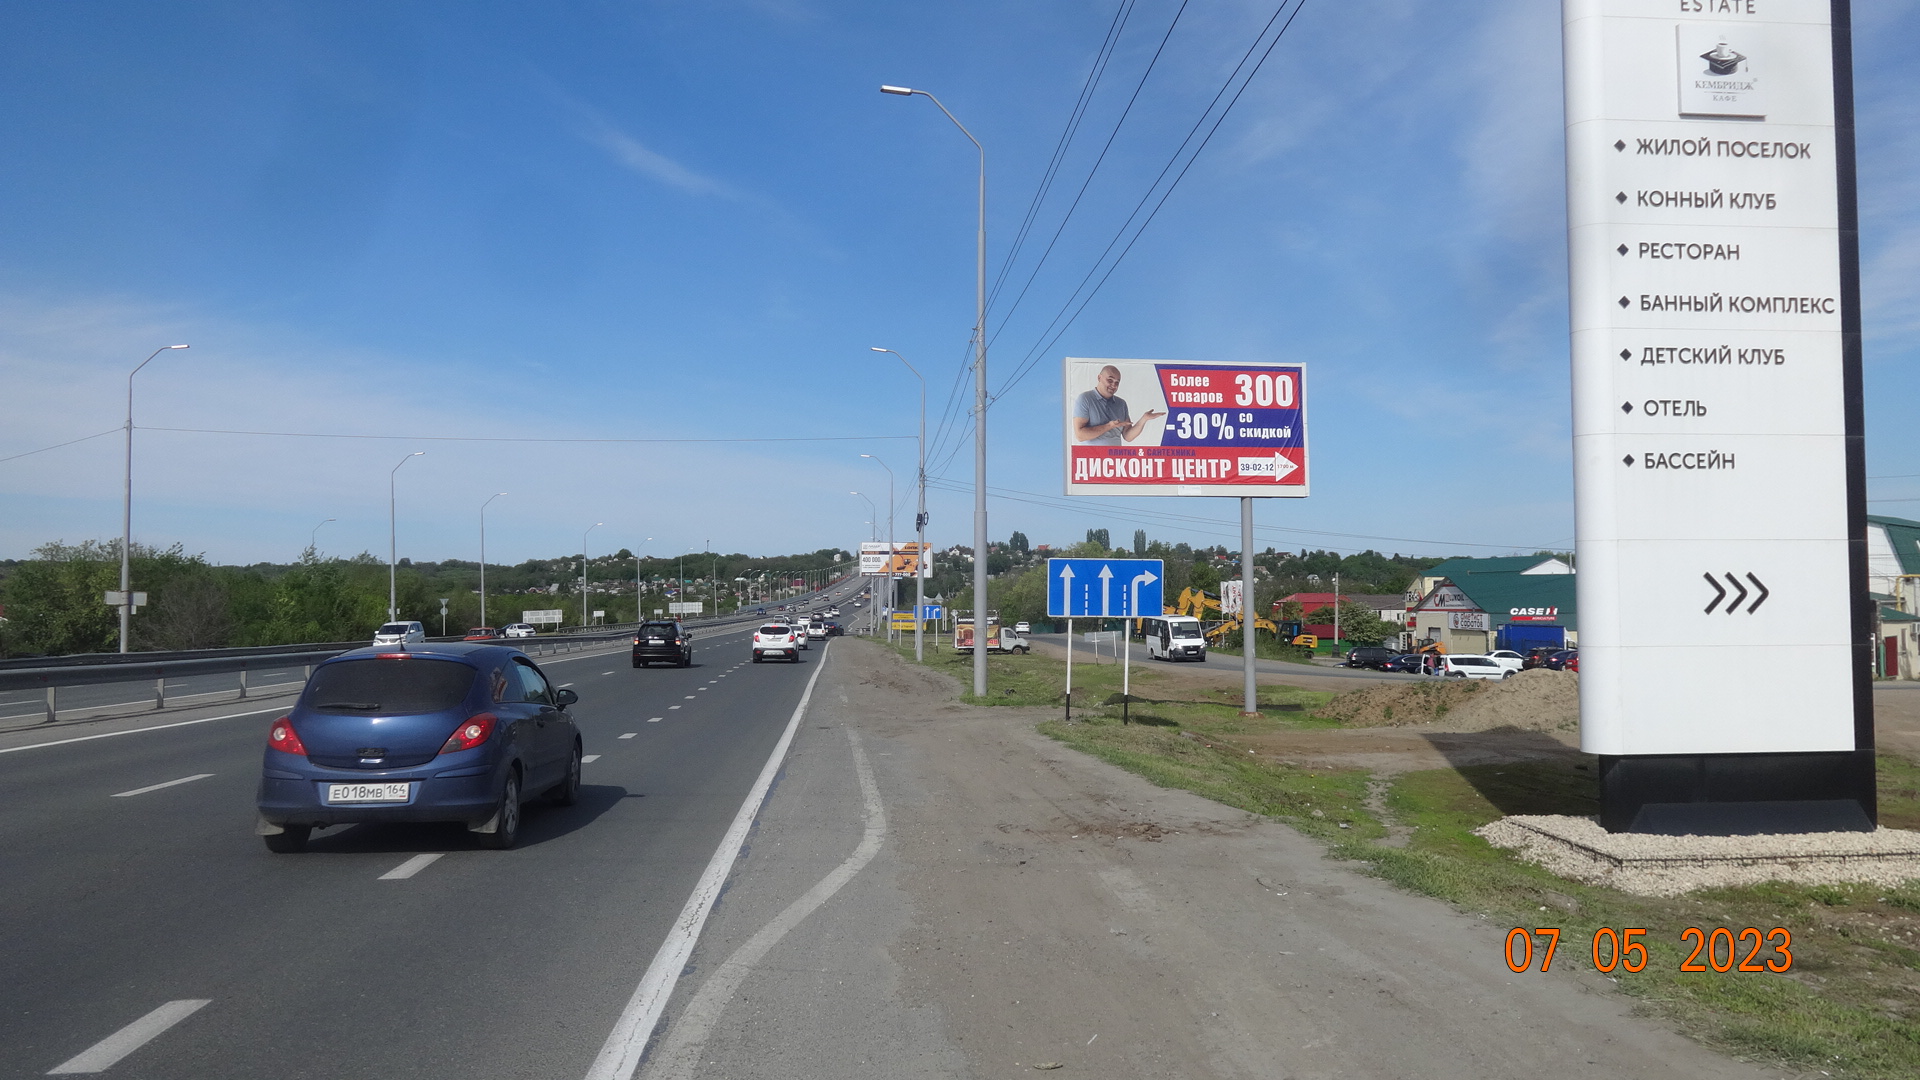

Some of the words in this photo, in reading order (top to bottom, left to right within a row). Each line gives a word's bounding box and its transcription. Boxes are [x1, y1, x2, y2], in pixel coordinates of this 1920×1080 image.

[1680, 0, 1756, 14] ESTATE
[1695, 80, 1754, 90] КЕМБРИДЖ
[1636, 136, 1711, 157] ЖИЛОЙ
[1717, 141, 1811, 159] ПОСЕЛОК
[1637, 189, 1723, 209] КОННЫЙ
[1730, 193, 1777, 210] КЛУБ
[1639, 242, 1740, 260] РЕСТОРАН
[1640, 293, 1723, 312] БАННЫЙ
[1729, 296, 1835, 314] КОМПЛЕКС
[1641, 345, 1732, 366] ДЕТСКИЙ
[1738, 348, 1785, 365] КЛУБ
[1170, 373, 1210, 387] Более
[1235, 373, 1294, 407] 300
[1171, 392, 1223, 404] товаров
[1643, 399, 1707, 416] ОТЕЛЬ
[1239, 413, 1254, 423] со
[1239, 426, 1291, 439] скидкой
[1138, 448, 1145, 457] &
[1146, 448, 1196, 457] САНТЕХНИКА
[1644, 450, 1735, 469] БАССЕЙН
[1075, 457, 1166, 481] ДИСКОНТ
[1172, 458, 1231, 480] ЦЕНТР
[1240, 462, 1274, 472] 39-02-12
[1509, 607, 1545, 615] CASE
[386, 784, 406, 794] 164
